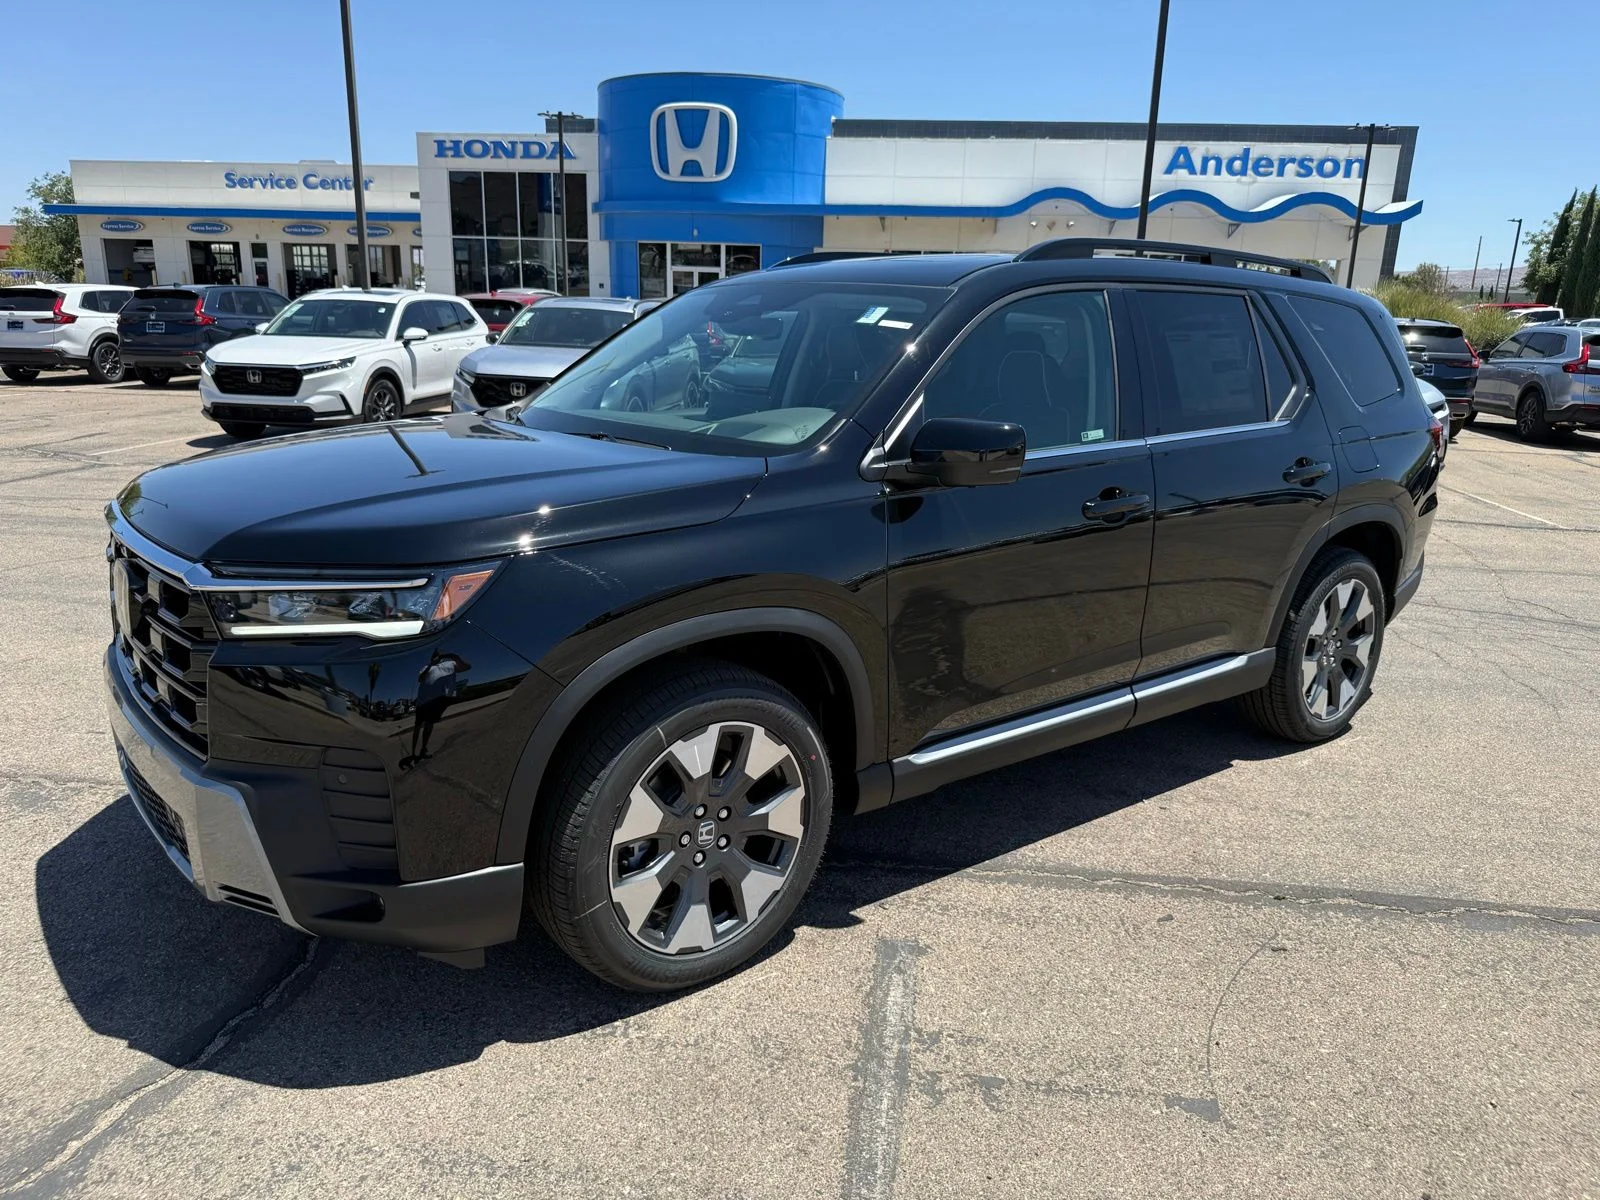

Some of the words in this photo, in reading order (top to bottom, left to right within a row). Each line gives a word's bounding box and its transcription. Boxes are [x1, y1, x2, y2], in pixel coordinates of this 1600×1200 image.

[433, 139, 577, 160] HONDA
[1163, 146, 1366, 179] Anderson
[224, 171, 297, 190] Service
[302, 172, 374, 191] Centr
